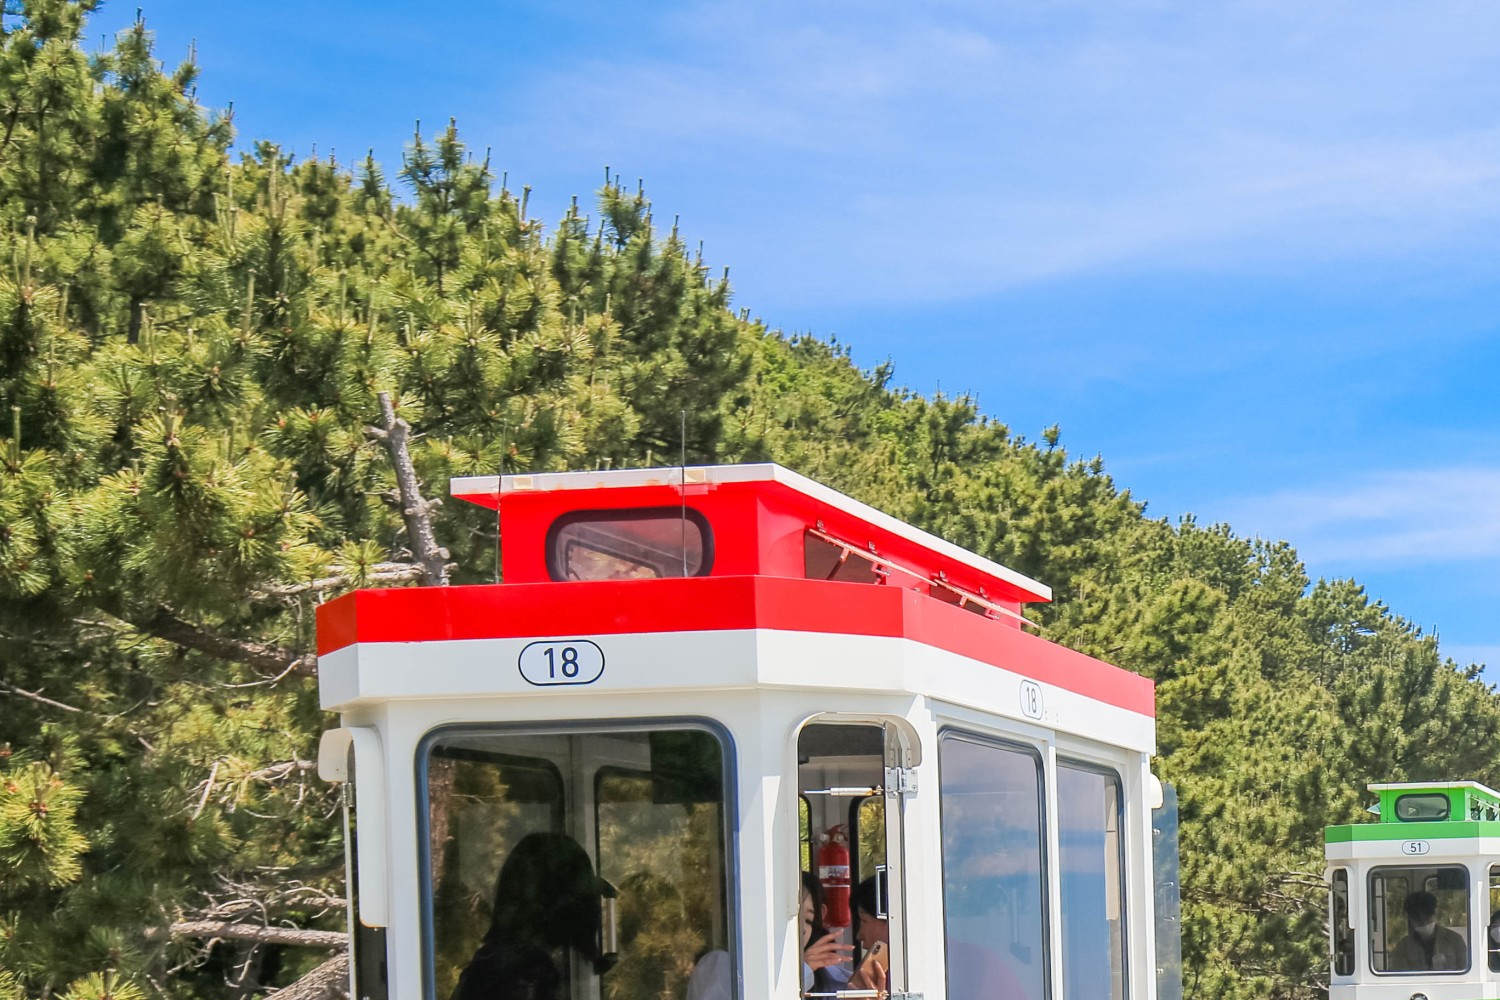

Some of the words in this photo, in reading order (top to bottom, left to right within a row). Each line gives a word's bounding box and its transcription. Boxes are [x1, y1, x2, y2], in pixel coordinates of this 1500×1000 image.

[543, 647, 579, 678] 18
[1026, 686, 1037, 713] 18
[1410, 842, 1422, 853] 51
